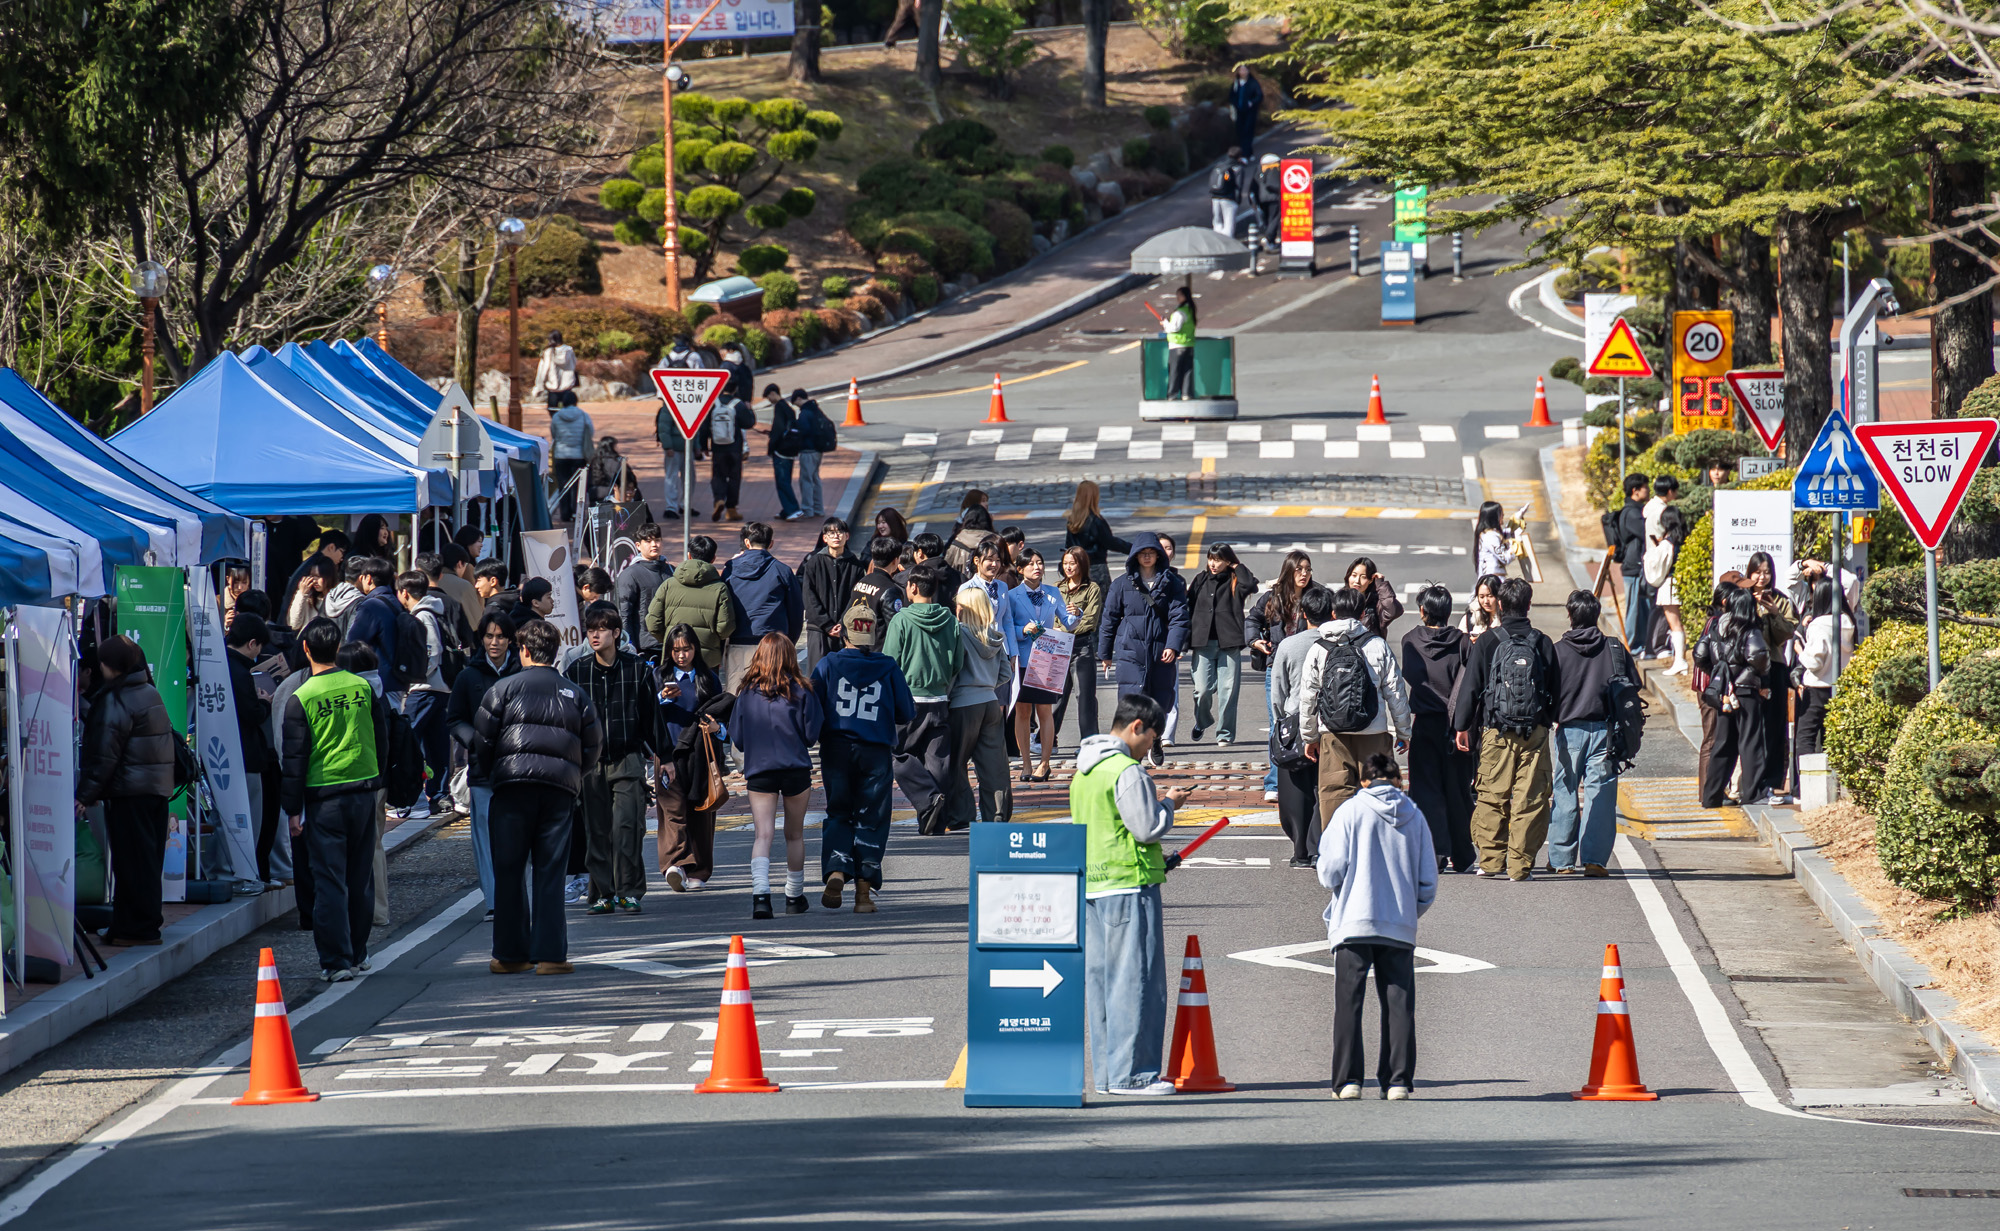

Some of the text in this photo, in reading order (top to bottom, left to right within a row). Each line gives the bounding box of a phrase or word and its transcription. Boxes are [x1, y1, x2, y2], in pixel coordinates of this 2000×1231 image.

[733, 11, 782, 31] 입니다.
[1690, 332, 1719, 352] 20
[1857, 350, 1867, 385] CCTV
[671, 379, 709, 393] 천천히
[676, 393, 703, 404] SLOW
[1681, 376, 1728, 416] 26
[1892, 437, 1959, 462] 천천히
[1903, 465, 1952, 483] SLOW
[1807, 492, 1865, 505] 횡단보도
[1736, 544, 1782, 552] 사회과학대학
[852, 619, 873, 634] NY
[317, 690, 367, 717] 상록수
[835, 676, 883, 722] 92
[1009, 851, 1046, 859] Information
[999, 1017, 1051, 1027] 계명대학교
